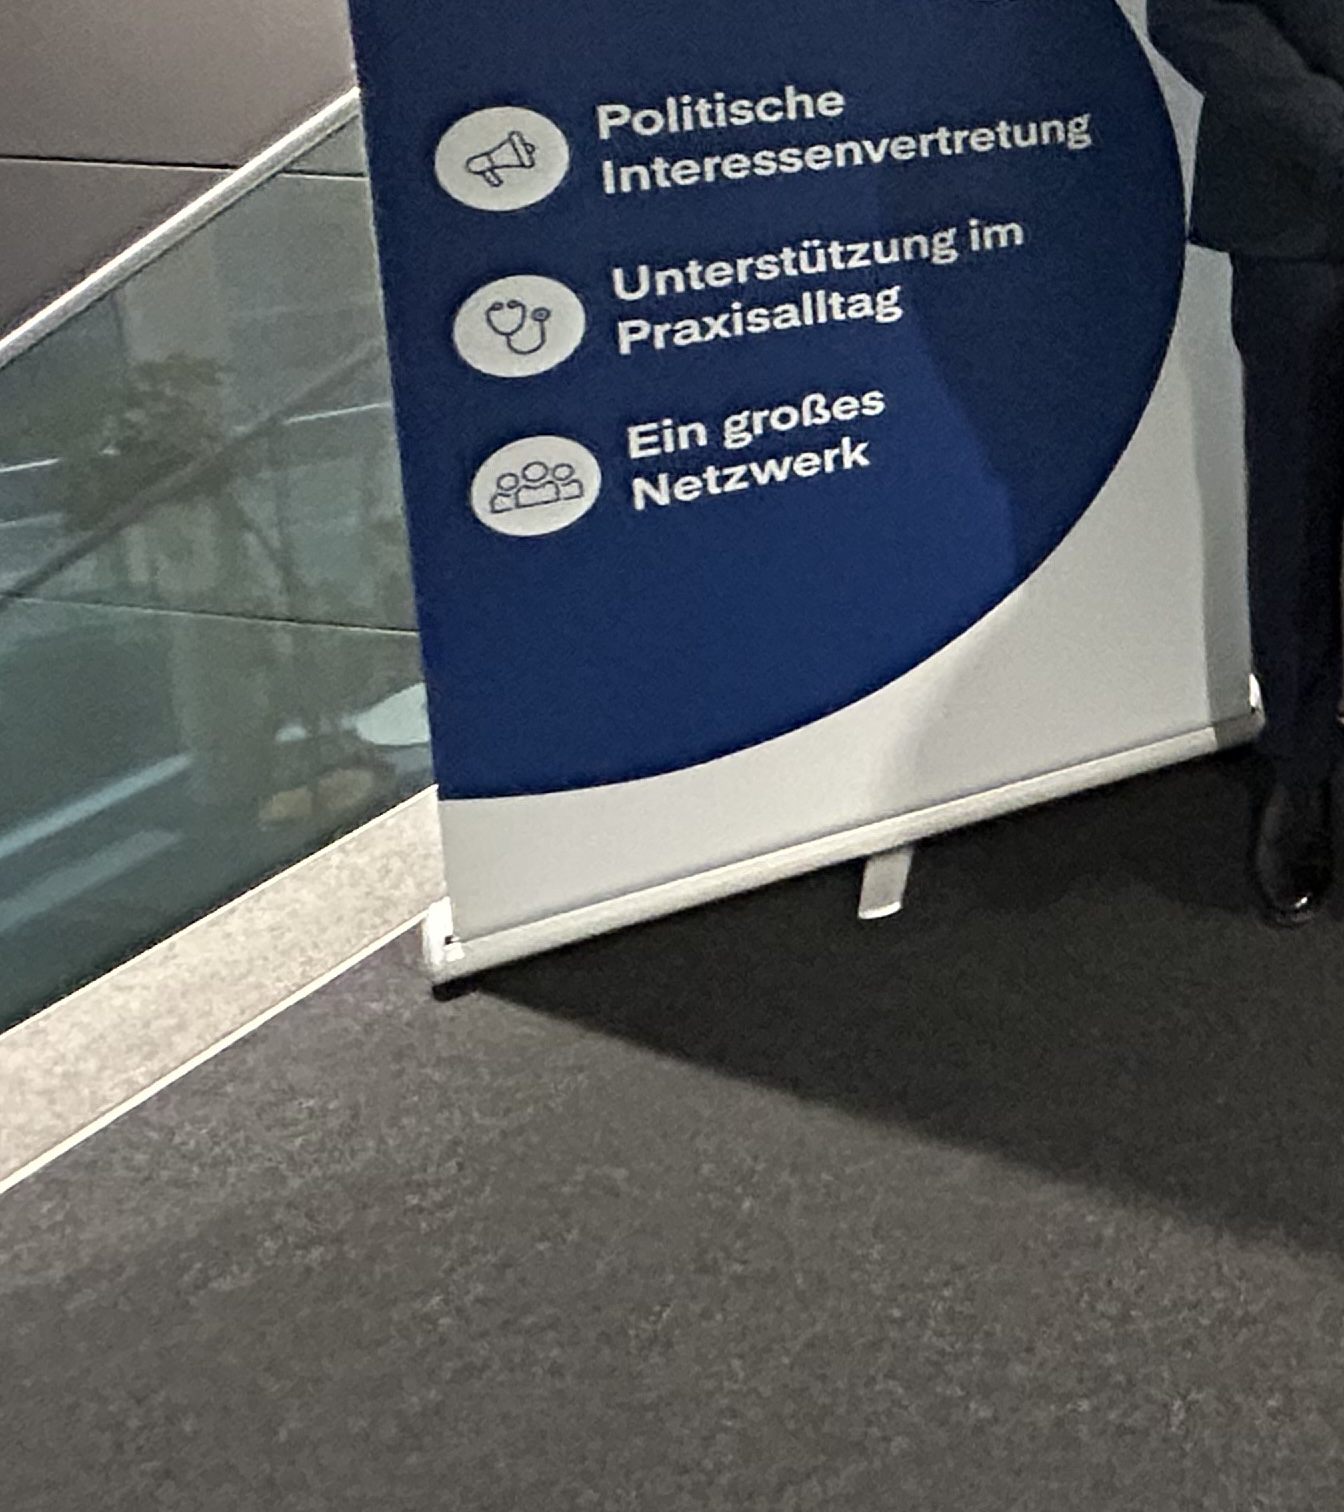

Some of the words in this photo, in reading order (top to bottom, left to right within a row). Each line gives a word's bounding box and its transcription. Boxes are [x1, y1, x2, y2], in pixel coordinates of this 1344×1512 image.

[596, 85, 846, 140] Politische
[602, 113, 1092, 194] Interessenvertretung
[612, 227, 959, 301] Unterstützung
[968, 218, 1024, 252] im
[617, 285, 904, 355] Praxisalltag
[627, 418, 708, 459] Ein
[723, 390, 886, 450] großes
[632, 436, 871, 511] Netzwerk
